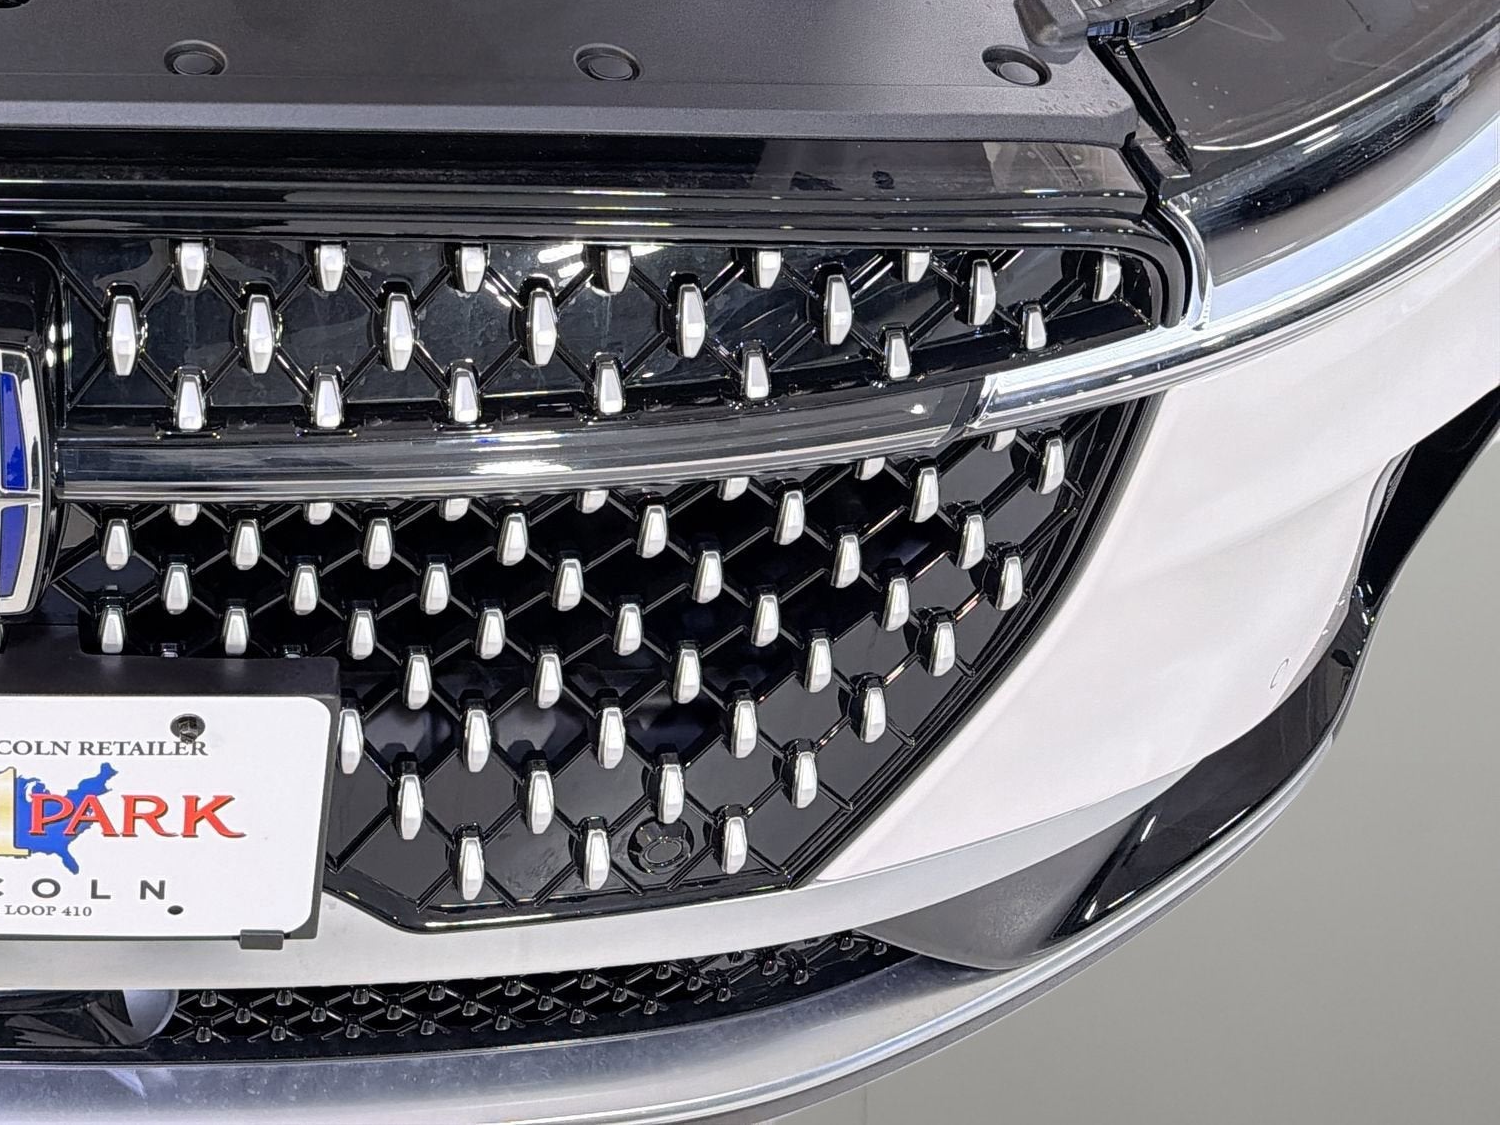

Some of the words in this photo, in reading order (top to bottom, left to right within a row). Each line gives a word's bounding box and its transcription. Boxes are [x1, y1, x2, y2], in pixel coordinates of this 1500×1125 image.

[78, 740, 209, 757] RETAILER
[28, 793, 246, 840] PARK
[5, 905, 57, 916] LOOP
[61, 906, 93, 917] 410
